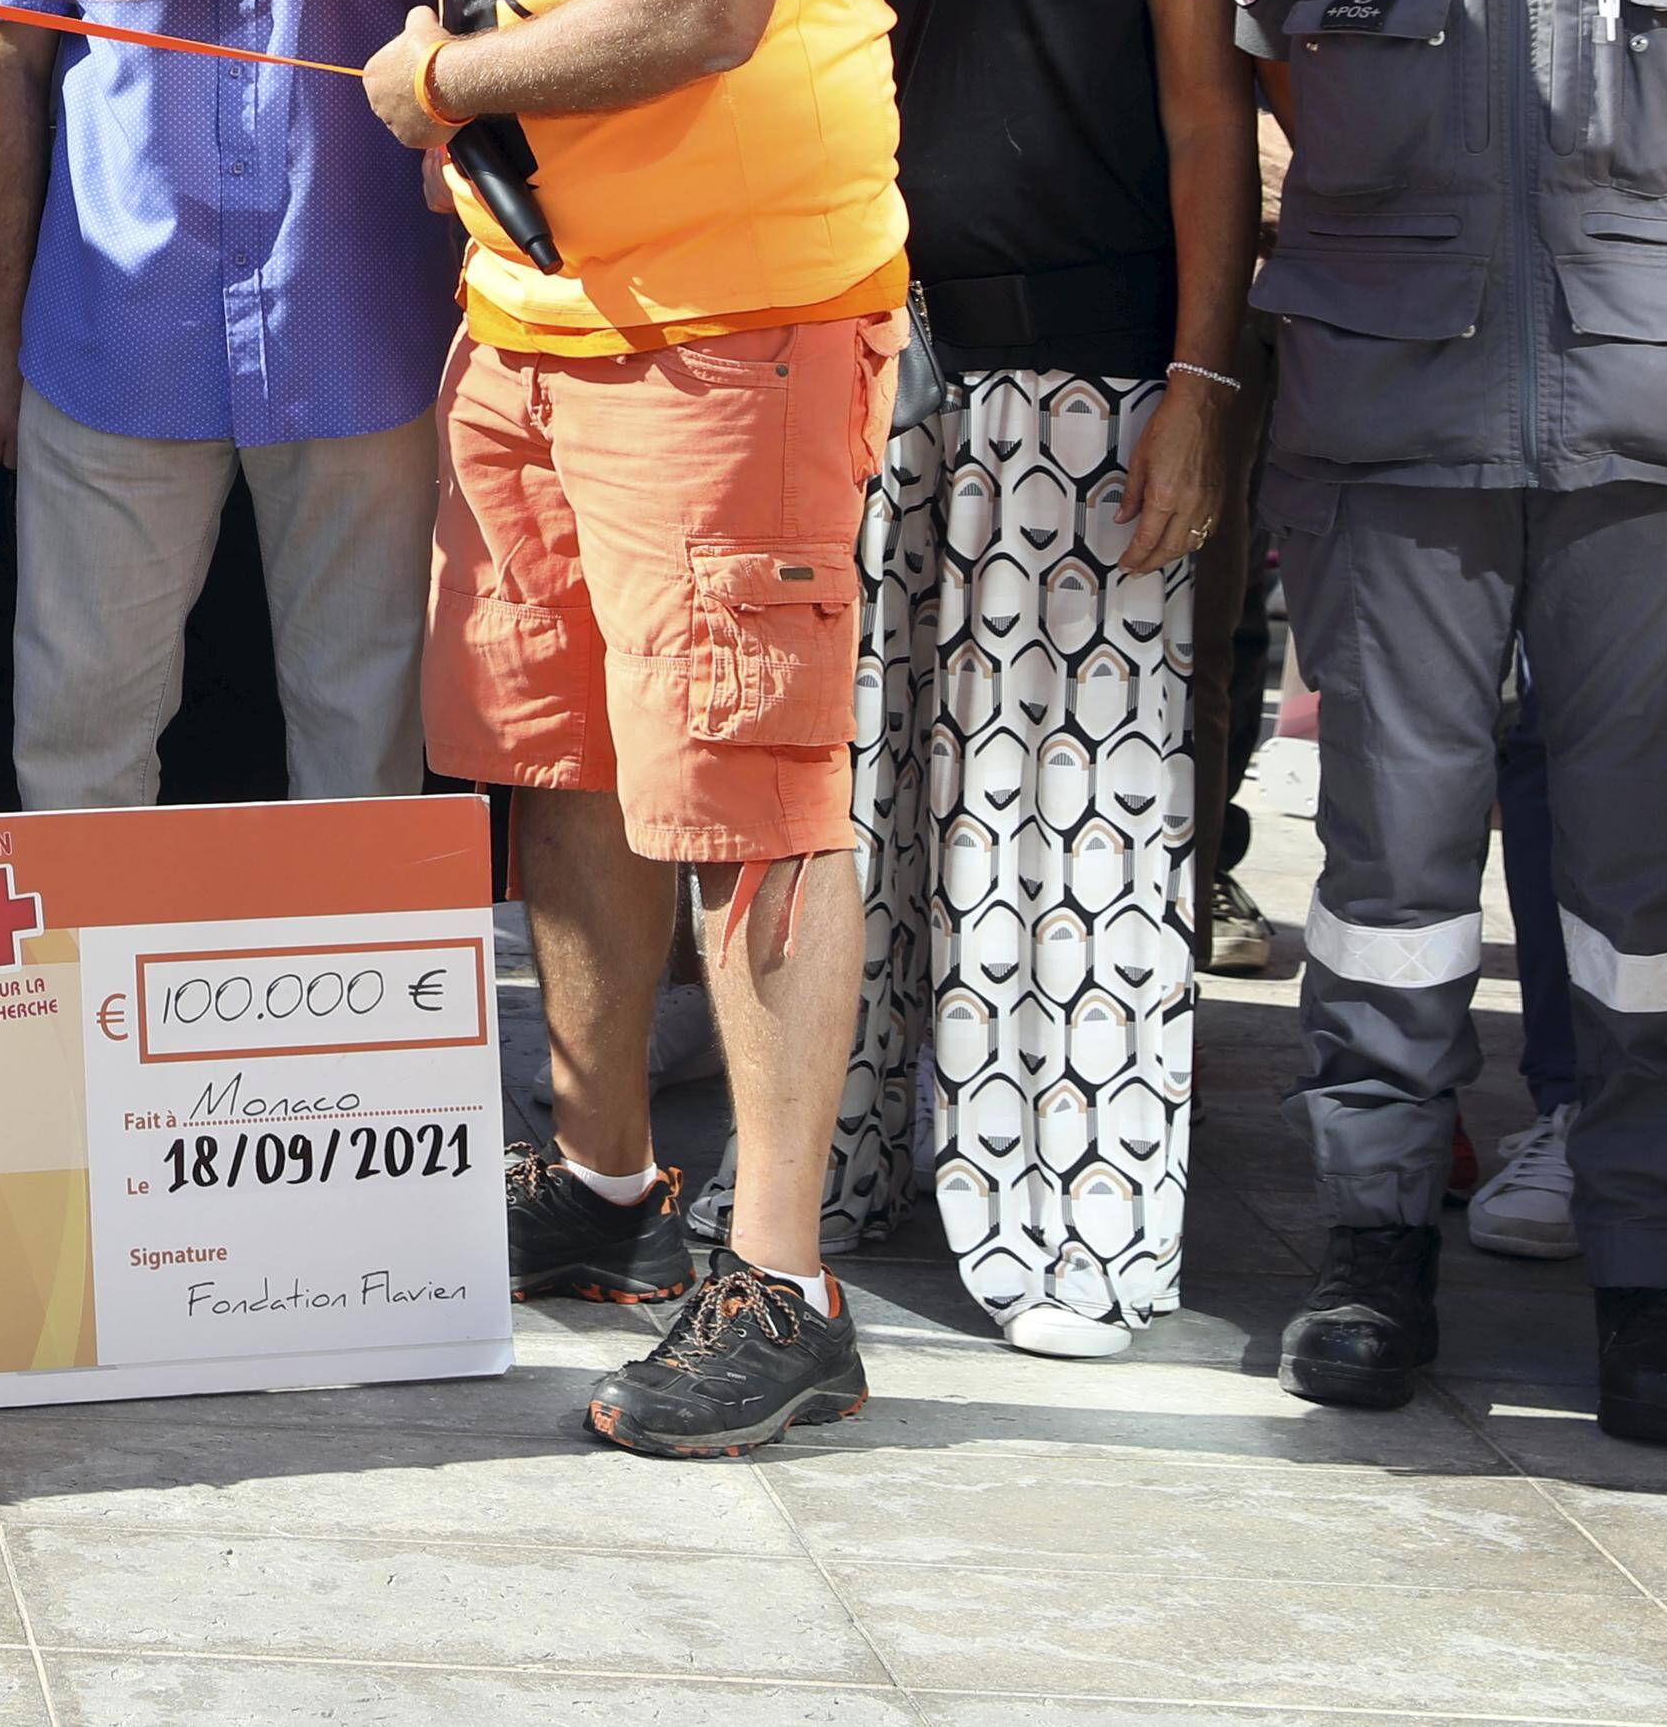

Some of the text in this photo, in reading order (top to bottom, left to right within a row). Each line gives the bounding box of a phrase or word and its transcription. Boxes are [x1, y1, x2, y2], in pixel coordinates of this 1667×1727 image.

[26, 977, 46, 994] LA
[162, 968, 447, 1024] 100.000 €
[96, 992, 129, 1041] €
[189, 1072, 361, 1120] Monaco
[123, 1111, 177, 1131] Fait à
[163, 1123, 472, 1193] 18/09/2021
[127, 1177, 150, 1195] Le
[130, 1245, 228, 1270] Signature
[187, 1270, 467, 1317] Fondation Flavien
